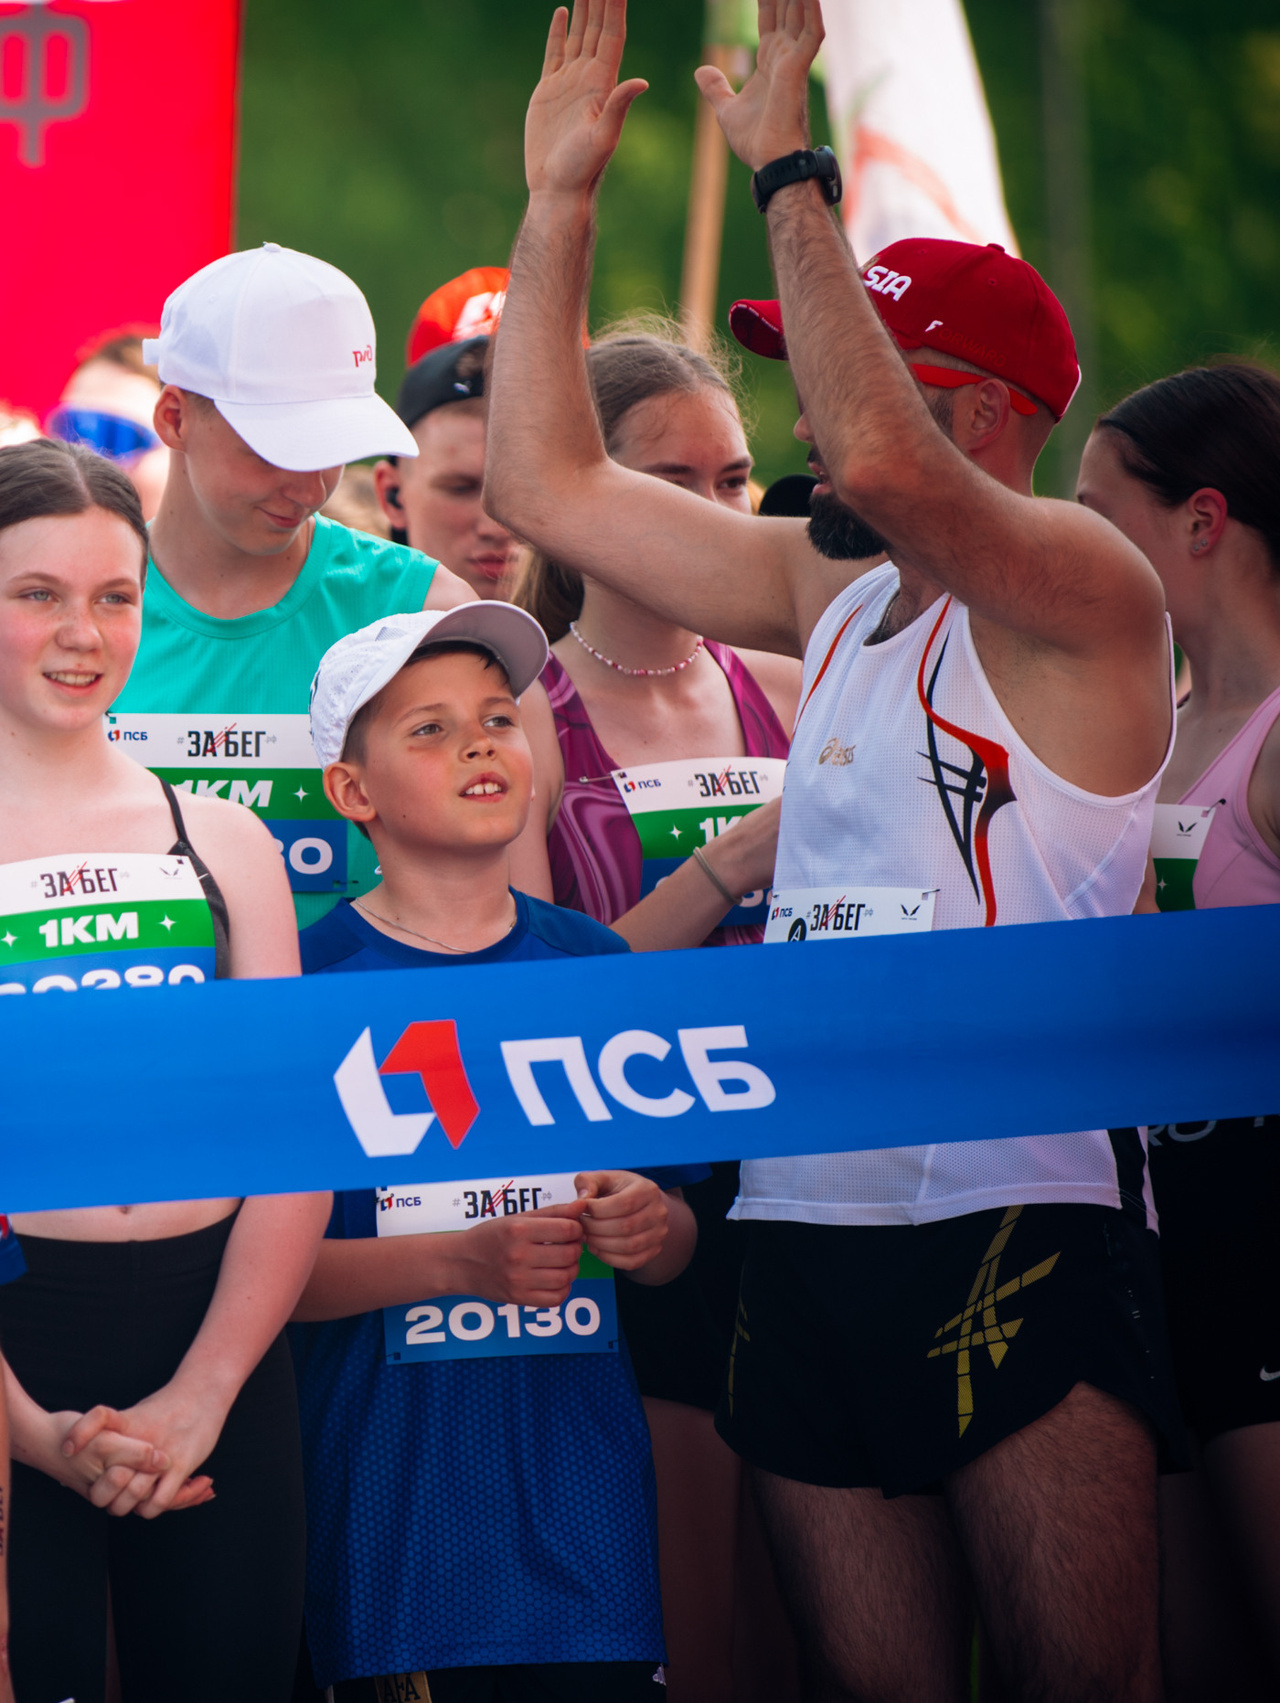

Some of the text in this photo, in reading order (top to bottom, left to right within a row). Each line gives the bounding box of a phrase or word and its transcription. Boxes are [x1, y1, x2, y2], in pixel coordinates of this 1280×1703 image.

[864, 265, 912, 301] SIA
[123, 731, 148, 741] ПСБ
[638, 779, 662, 789] ПСБ
[500, 1025, 776, 1126] ПСБ
[396, 1197, 422, 1208] ПСБ
[405, 1297, 601, 1345] 20130
